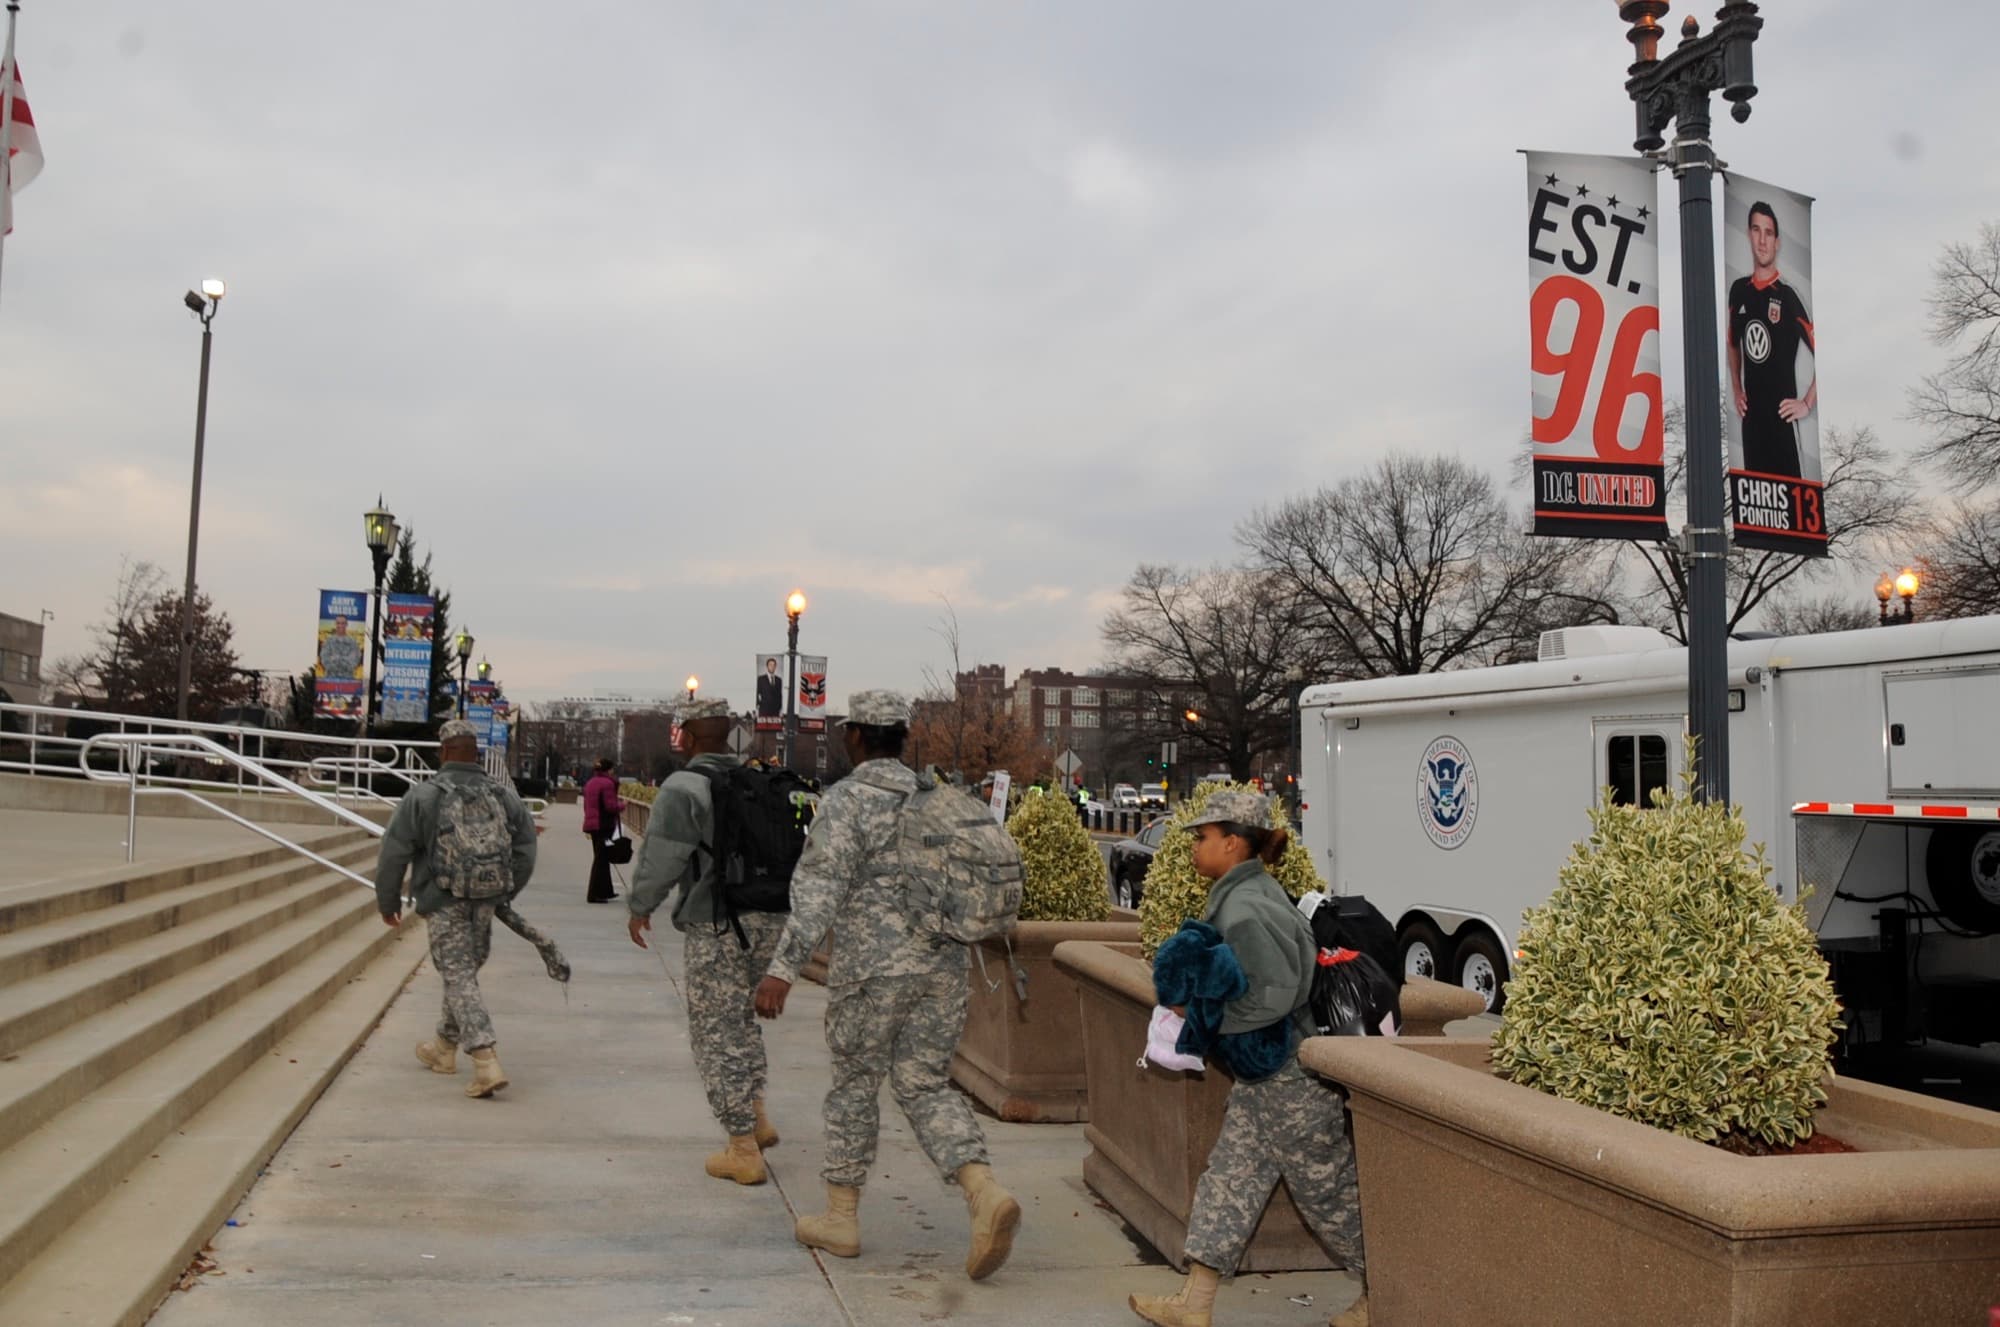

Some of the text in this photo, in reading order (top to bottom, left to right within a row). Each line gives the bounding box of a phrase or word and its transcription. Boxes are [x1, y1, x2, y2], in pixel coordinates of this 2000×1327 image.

[1529, 188, 1646, 294] EST.
[1530, 275, 1664, 463] 96
[1543, 471, 1656, 508] D.C. UNITED
[1738, 478, 1789, 510] CHRIS
[1739, 505, 1790, 530] PONTIUS
[1791, 486, 1821, 533] 13
[384, 648, 431, 660] INTEGRITY
[384, 665, 430, 678] PERSONAL
[384, 677, 427, 689] COURAGE
[1450, 801, 1476, 844] SECURITY
[1004, 888, 1020, 906] US
